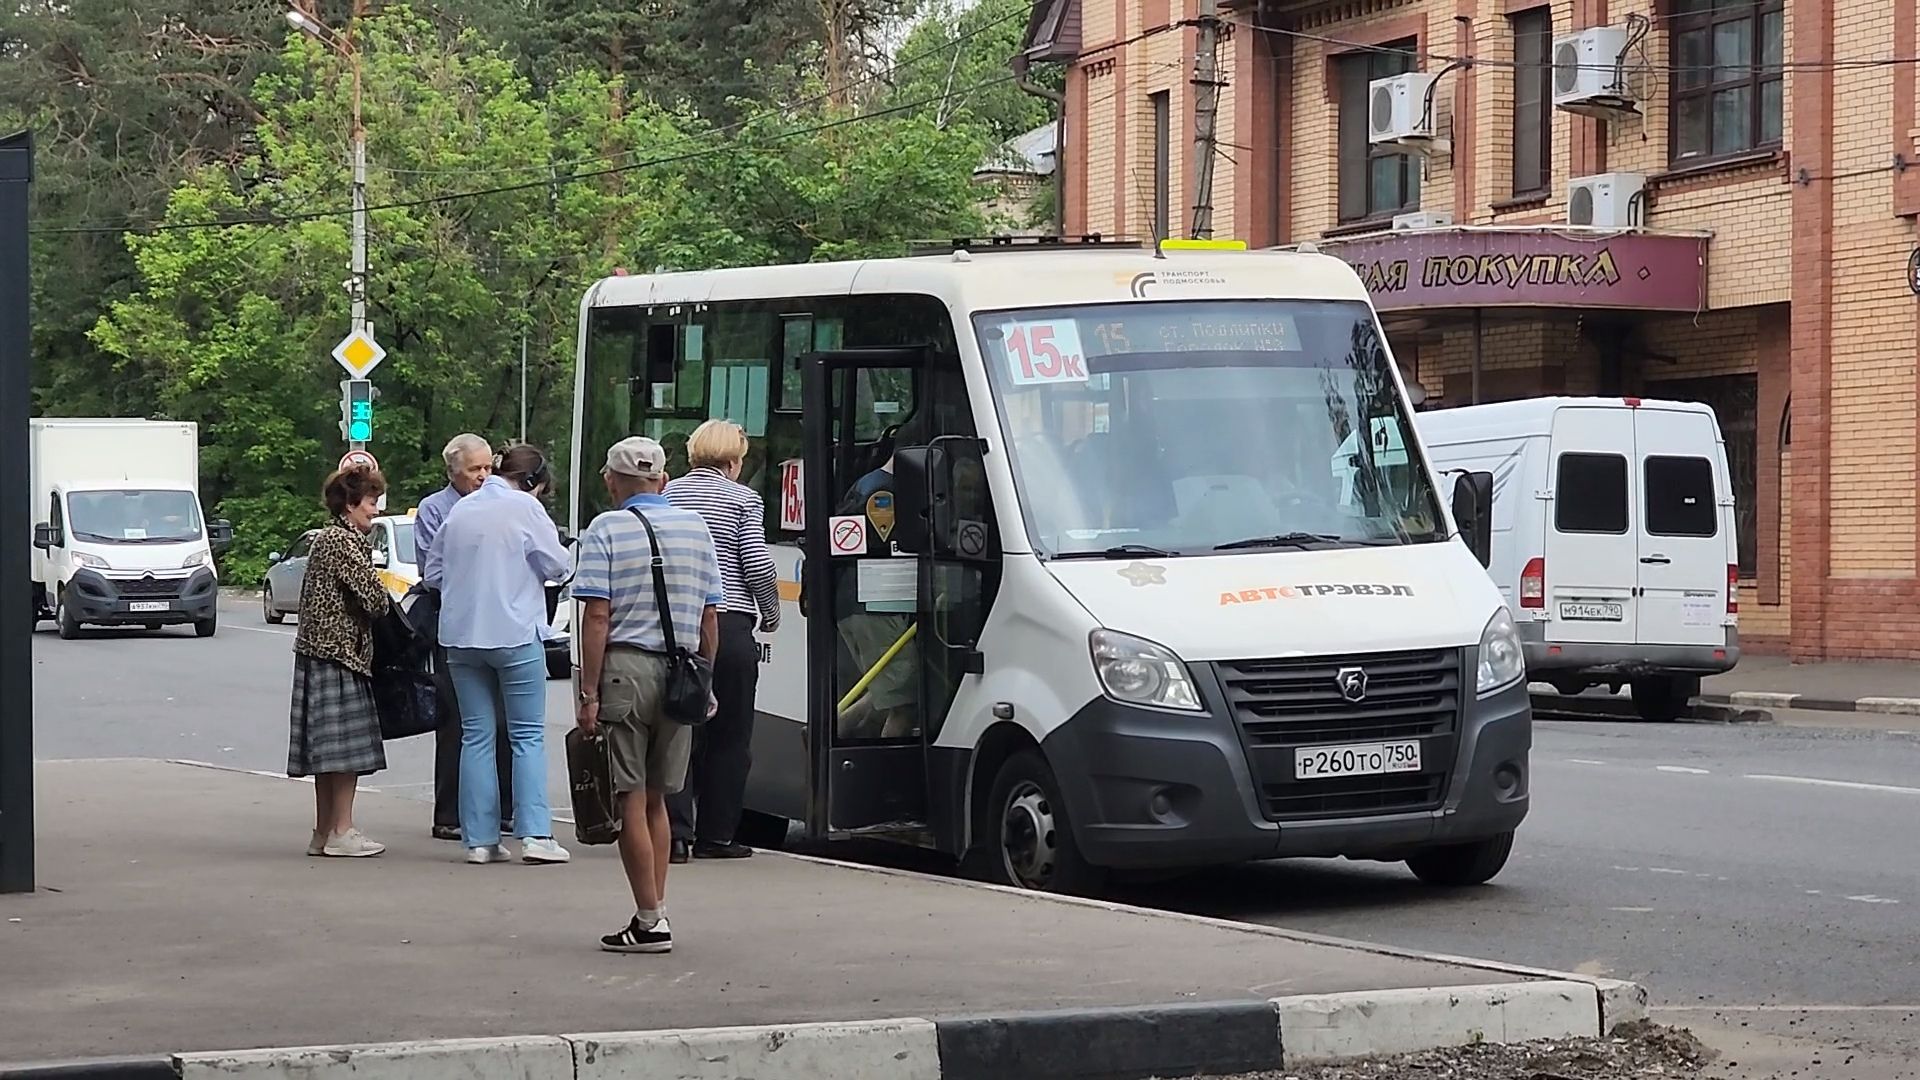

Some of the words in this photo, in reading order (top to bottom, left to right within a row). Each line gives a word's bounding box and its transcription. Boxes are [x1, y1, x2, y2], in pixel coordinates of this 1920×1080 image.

[1422, 248, 1621, 289] ПОКУПКА
[1094, 322, 1131, 355] 15
[1385, 744, 1415, 763] 750
